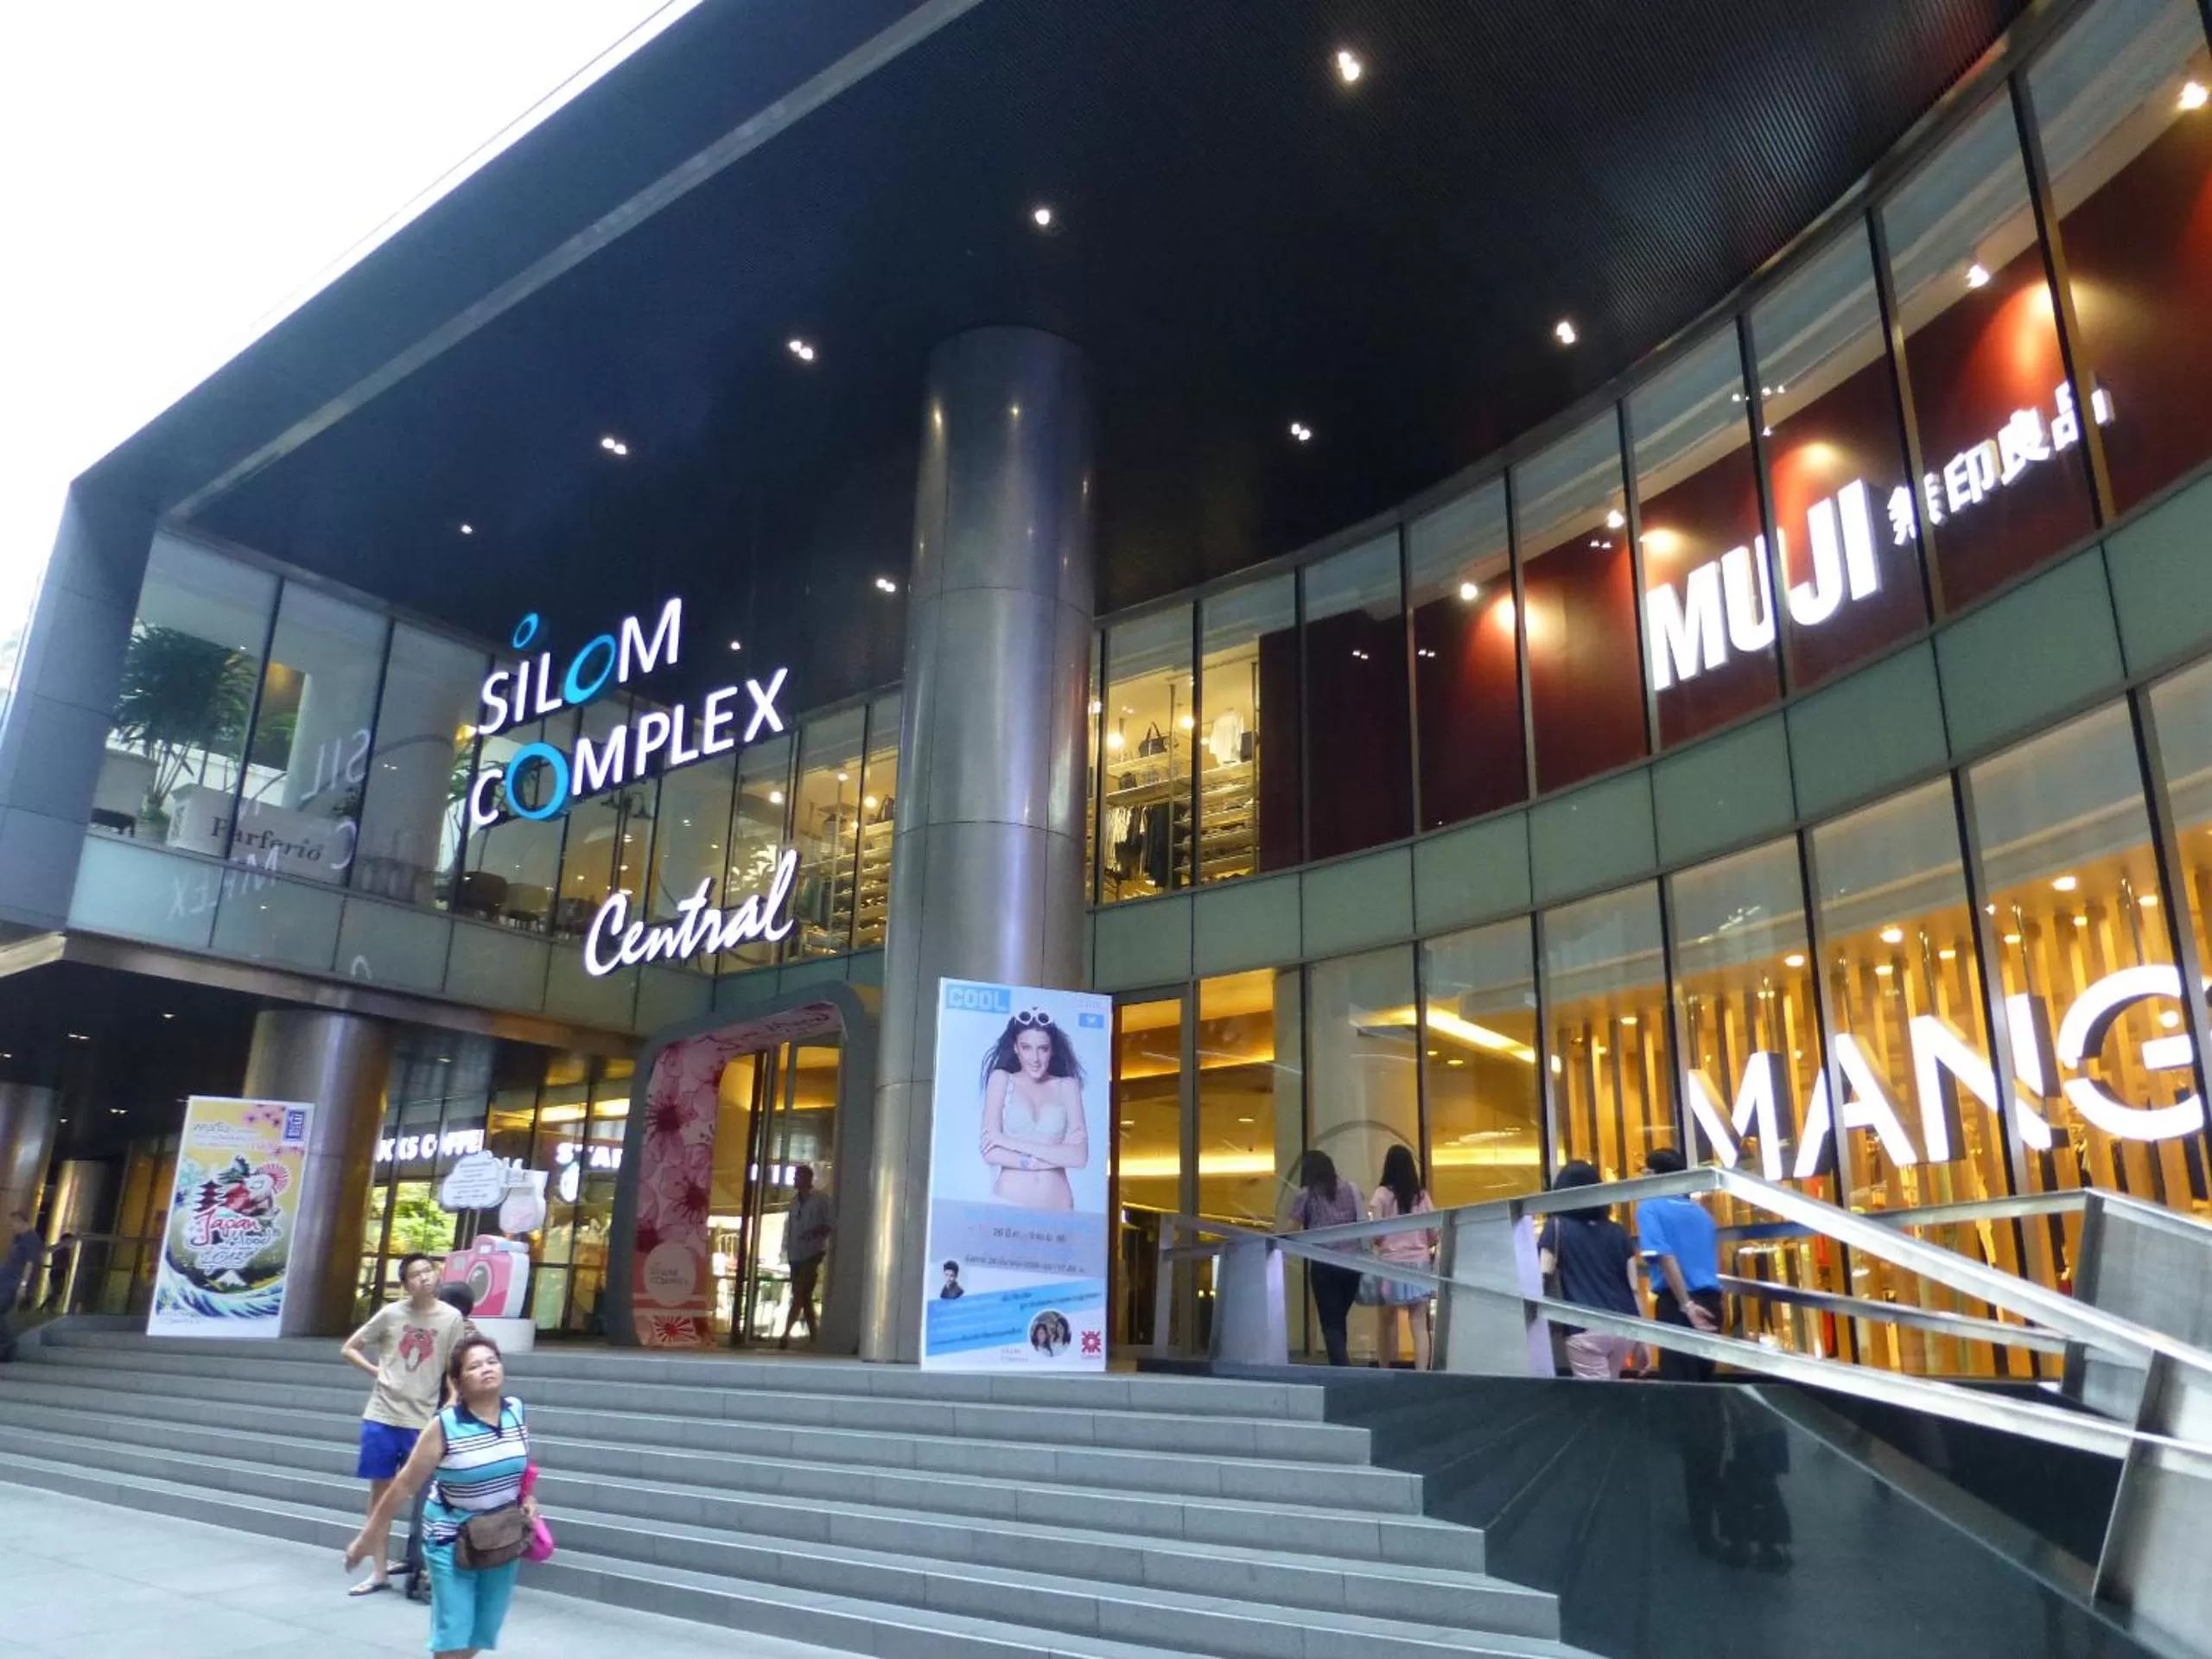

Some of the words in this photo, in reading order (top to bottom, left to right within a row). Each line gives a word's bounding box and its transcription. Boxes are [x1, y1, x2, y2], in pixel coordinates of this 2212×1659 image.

[1646, 479, 1882, 691] MUJI
[475, 596, 683, 736] SILOM
[467, 666, 790, 827] COMPLEX
[583, 849, 799, 976] Central
[948, 986, 1008, 1012] COOL
[190, 1205, 259, 1246] Japan
